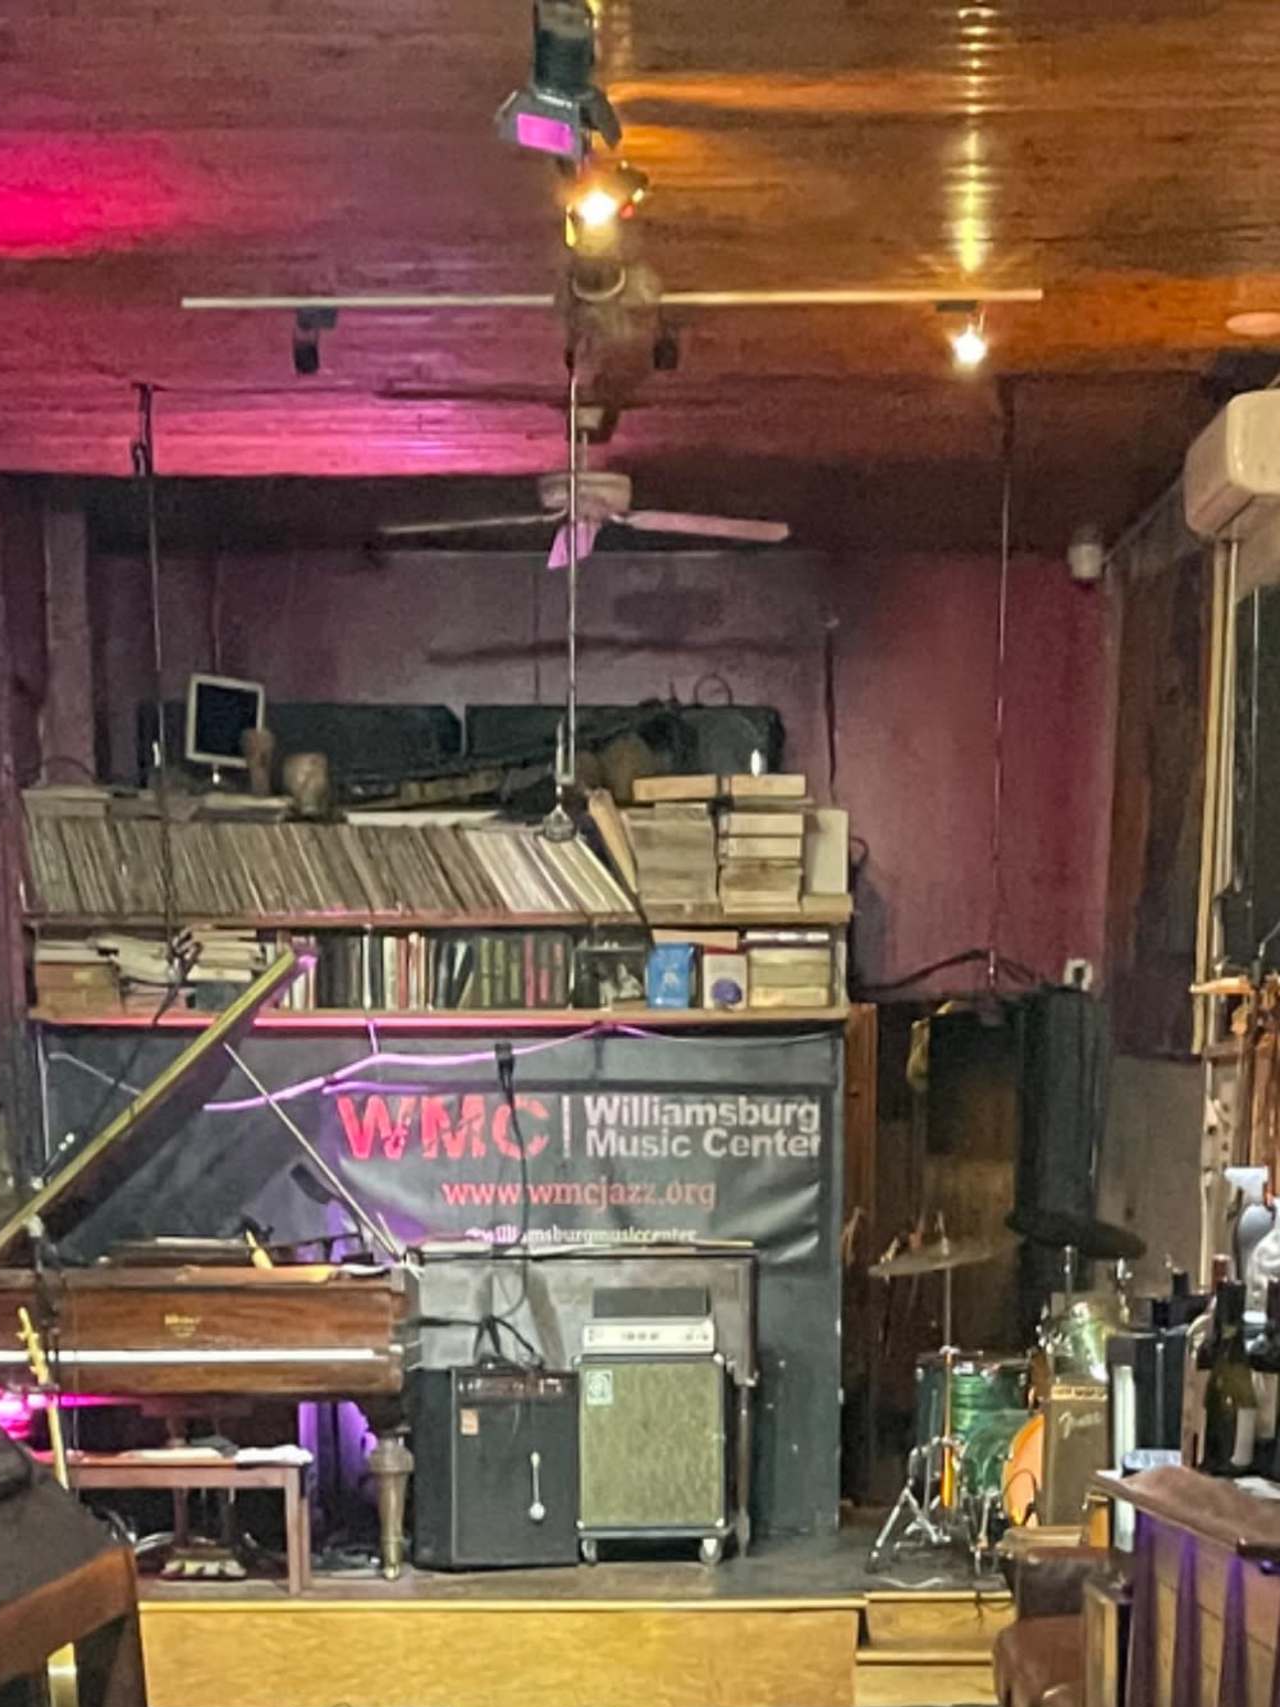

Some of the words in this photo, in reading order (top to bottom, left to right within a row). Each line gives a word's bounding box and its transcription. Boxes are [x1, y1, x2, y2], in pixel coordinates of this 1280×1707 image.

[336, 1094, 549, 1160] WMC
[583, 1095, 819, 1133] Williamsburg
[586, 1128, 692, 1157] Music
[702, 1128, 821, 1158] Center
[442, 1177, 717, 1212] wwwwmcjazz.org
